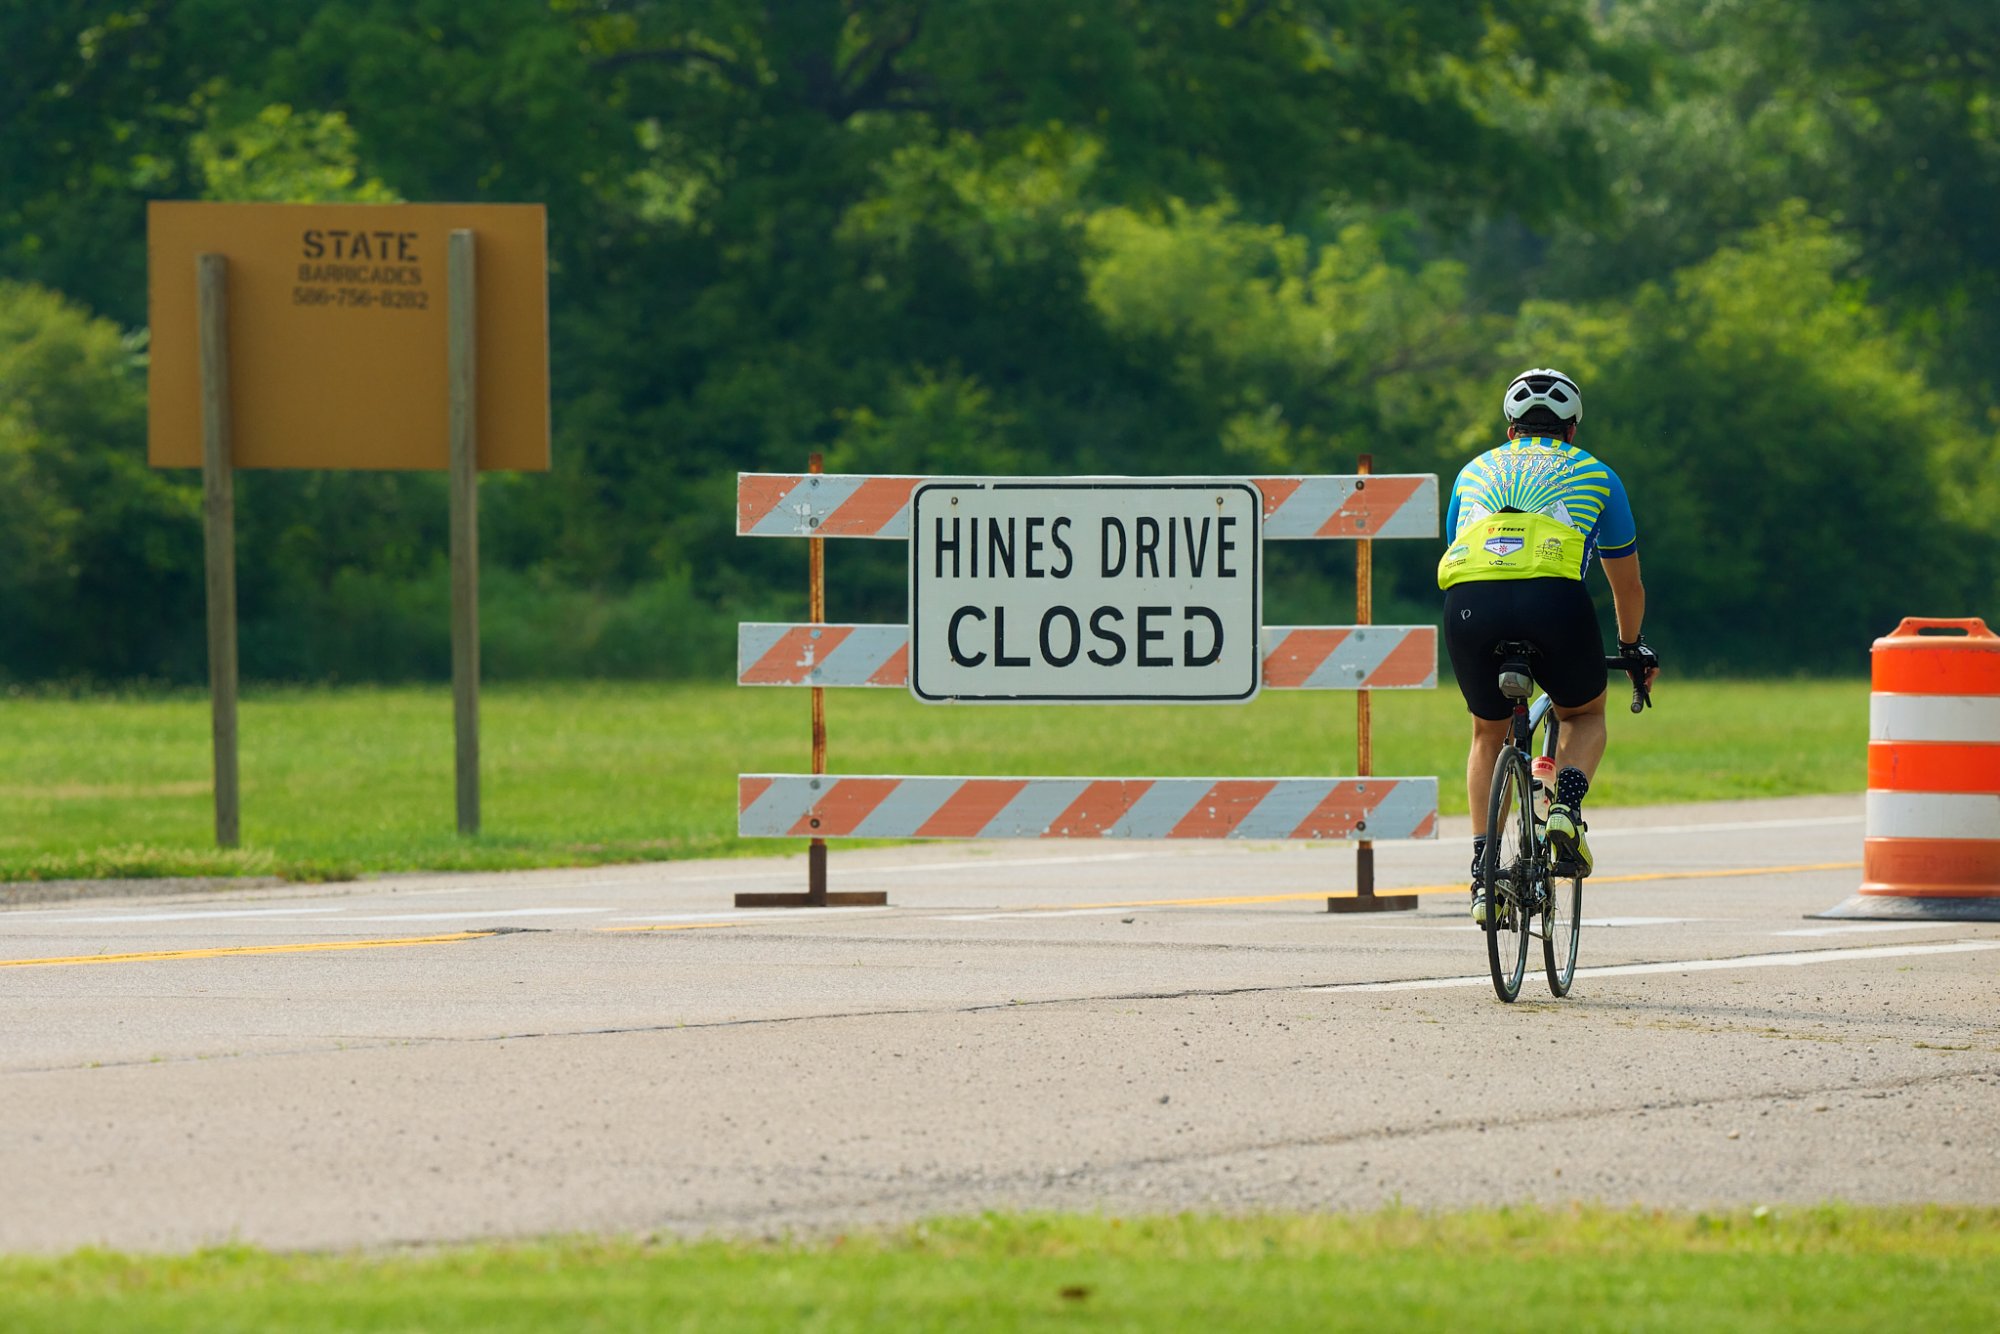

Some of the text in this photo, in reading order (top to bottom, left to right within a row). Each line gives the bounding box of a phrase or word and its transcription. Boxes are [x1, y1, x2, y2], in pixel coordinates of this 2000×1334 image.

[303, 230, 418, 262] STATE
[298, 263, 422, 285] BARRICADES
[935, 515, 1237, 579] HINES DRIVE
[947, 605, 1224, 668] CLOSED
